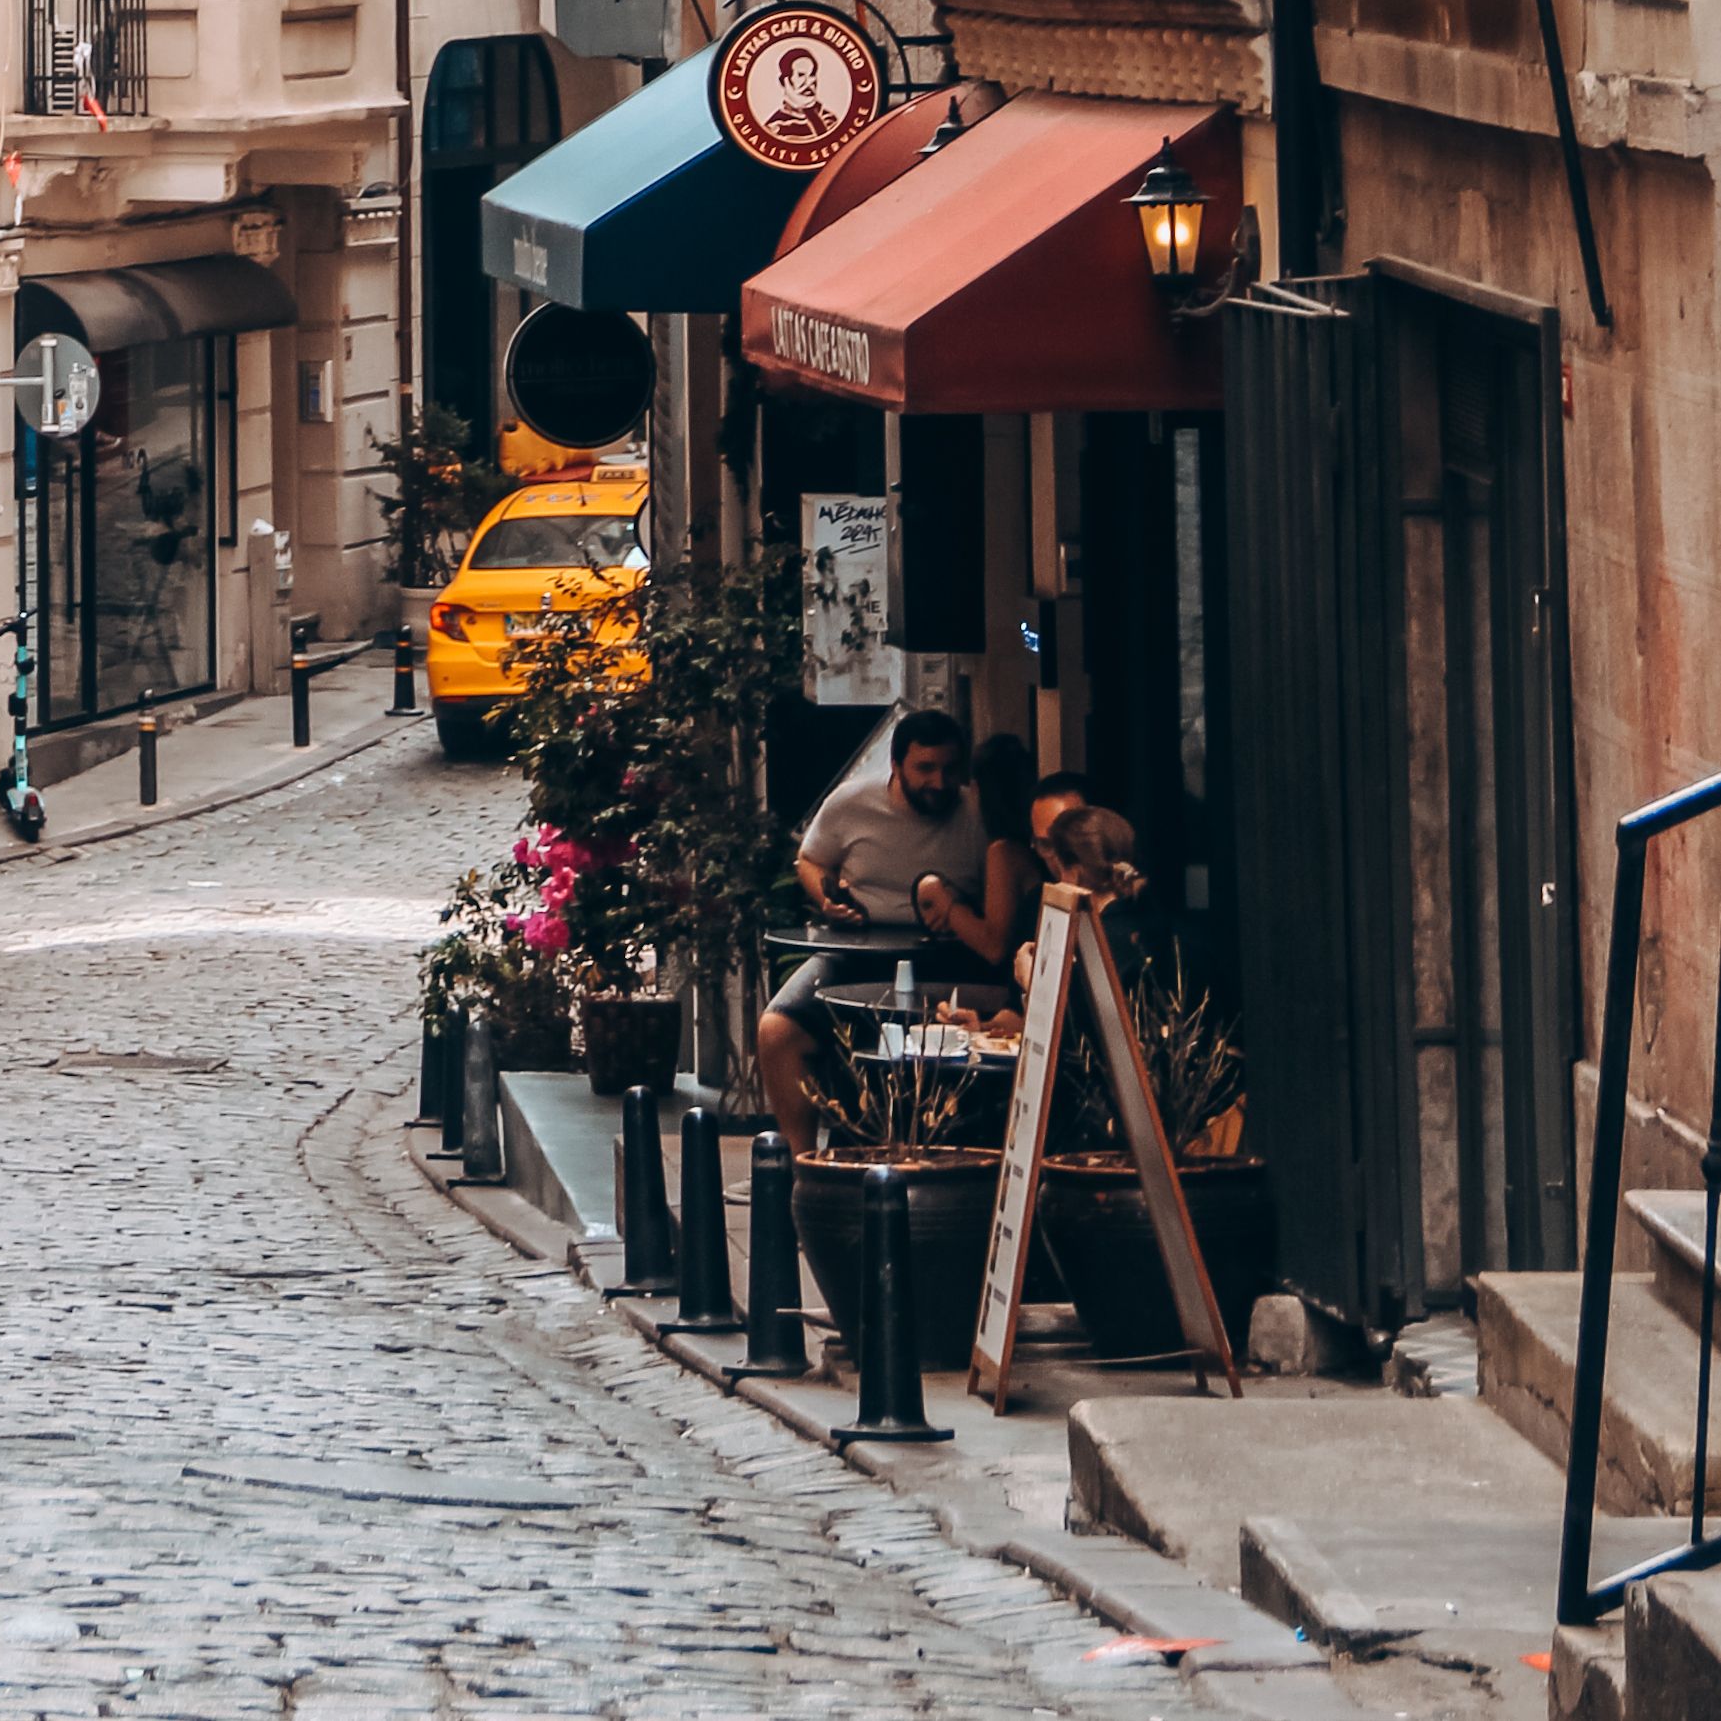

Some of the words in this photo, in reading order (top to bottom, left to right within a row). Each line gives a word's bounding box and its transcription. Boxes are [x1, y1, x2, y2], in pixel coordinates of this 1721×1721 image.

[731, 29, 771, 77] LATTAS
[771, 18, 808, 38] CAFE
[810, 21, 822, 36] &
[823, 26, 865, 70] BISTRO
[732, 113, 799, 162] QUALITY
